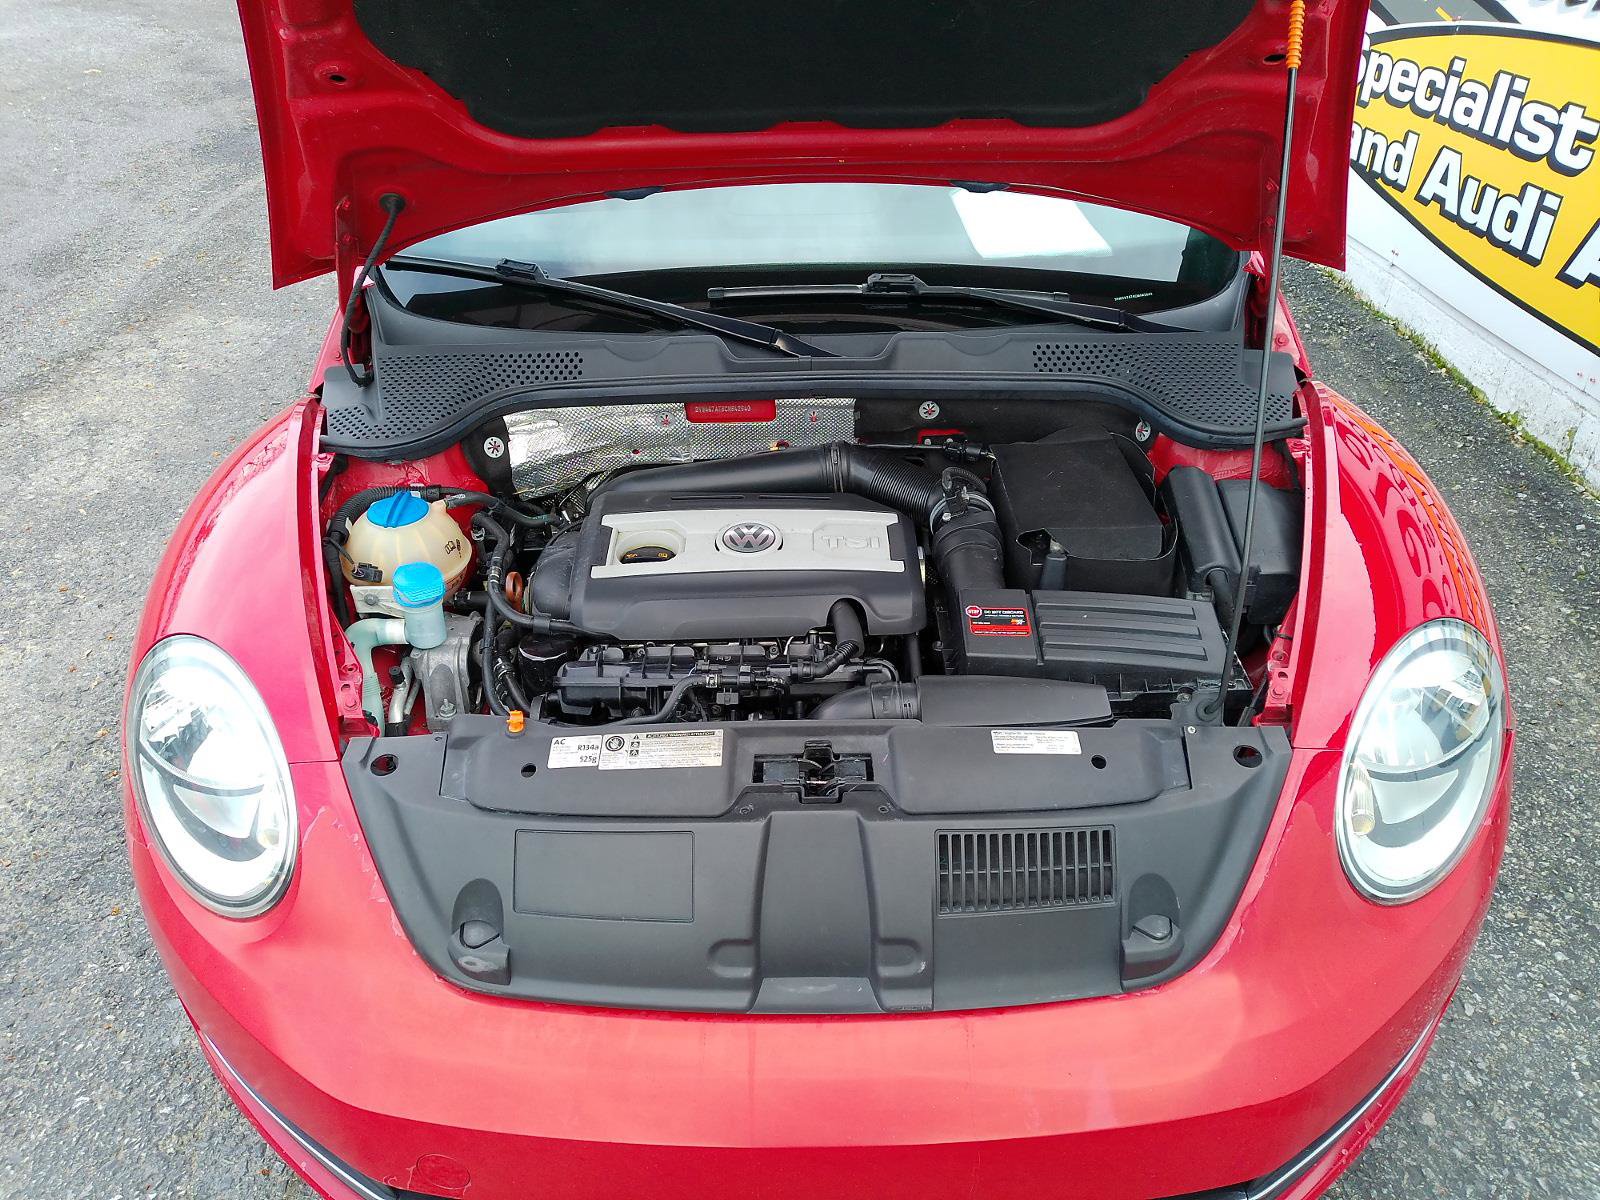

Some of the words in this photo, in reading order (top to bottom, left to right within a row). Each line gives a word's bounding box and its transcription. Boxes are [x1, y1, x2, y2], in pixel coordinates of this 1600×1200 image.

[1414, 145, 1564, 267] Audi
[821, 535, 881, 549] TSI
[579, 756, 597, 764] 525g
